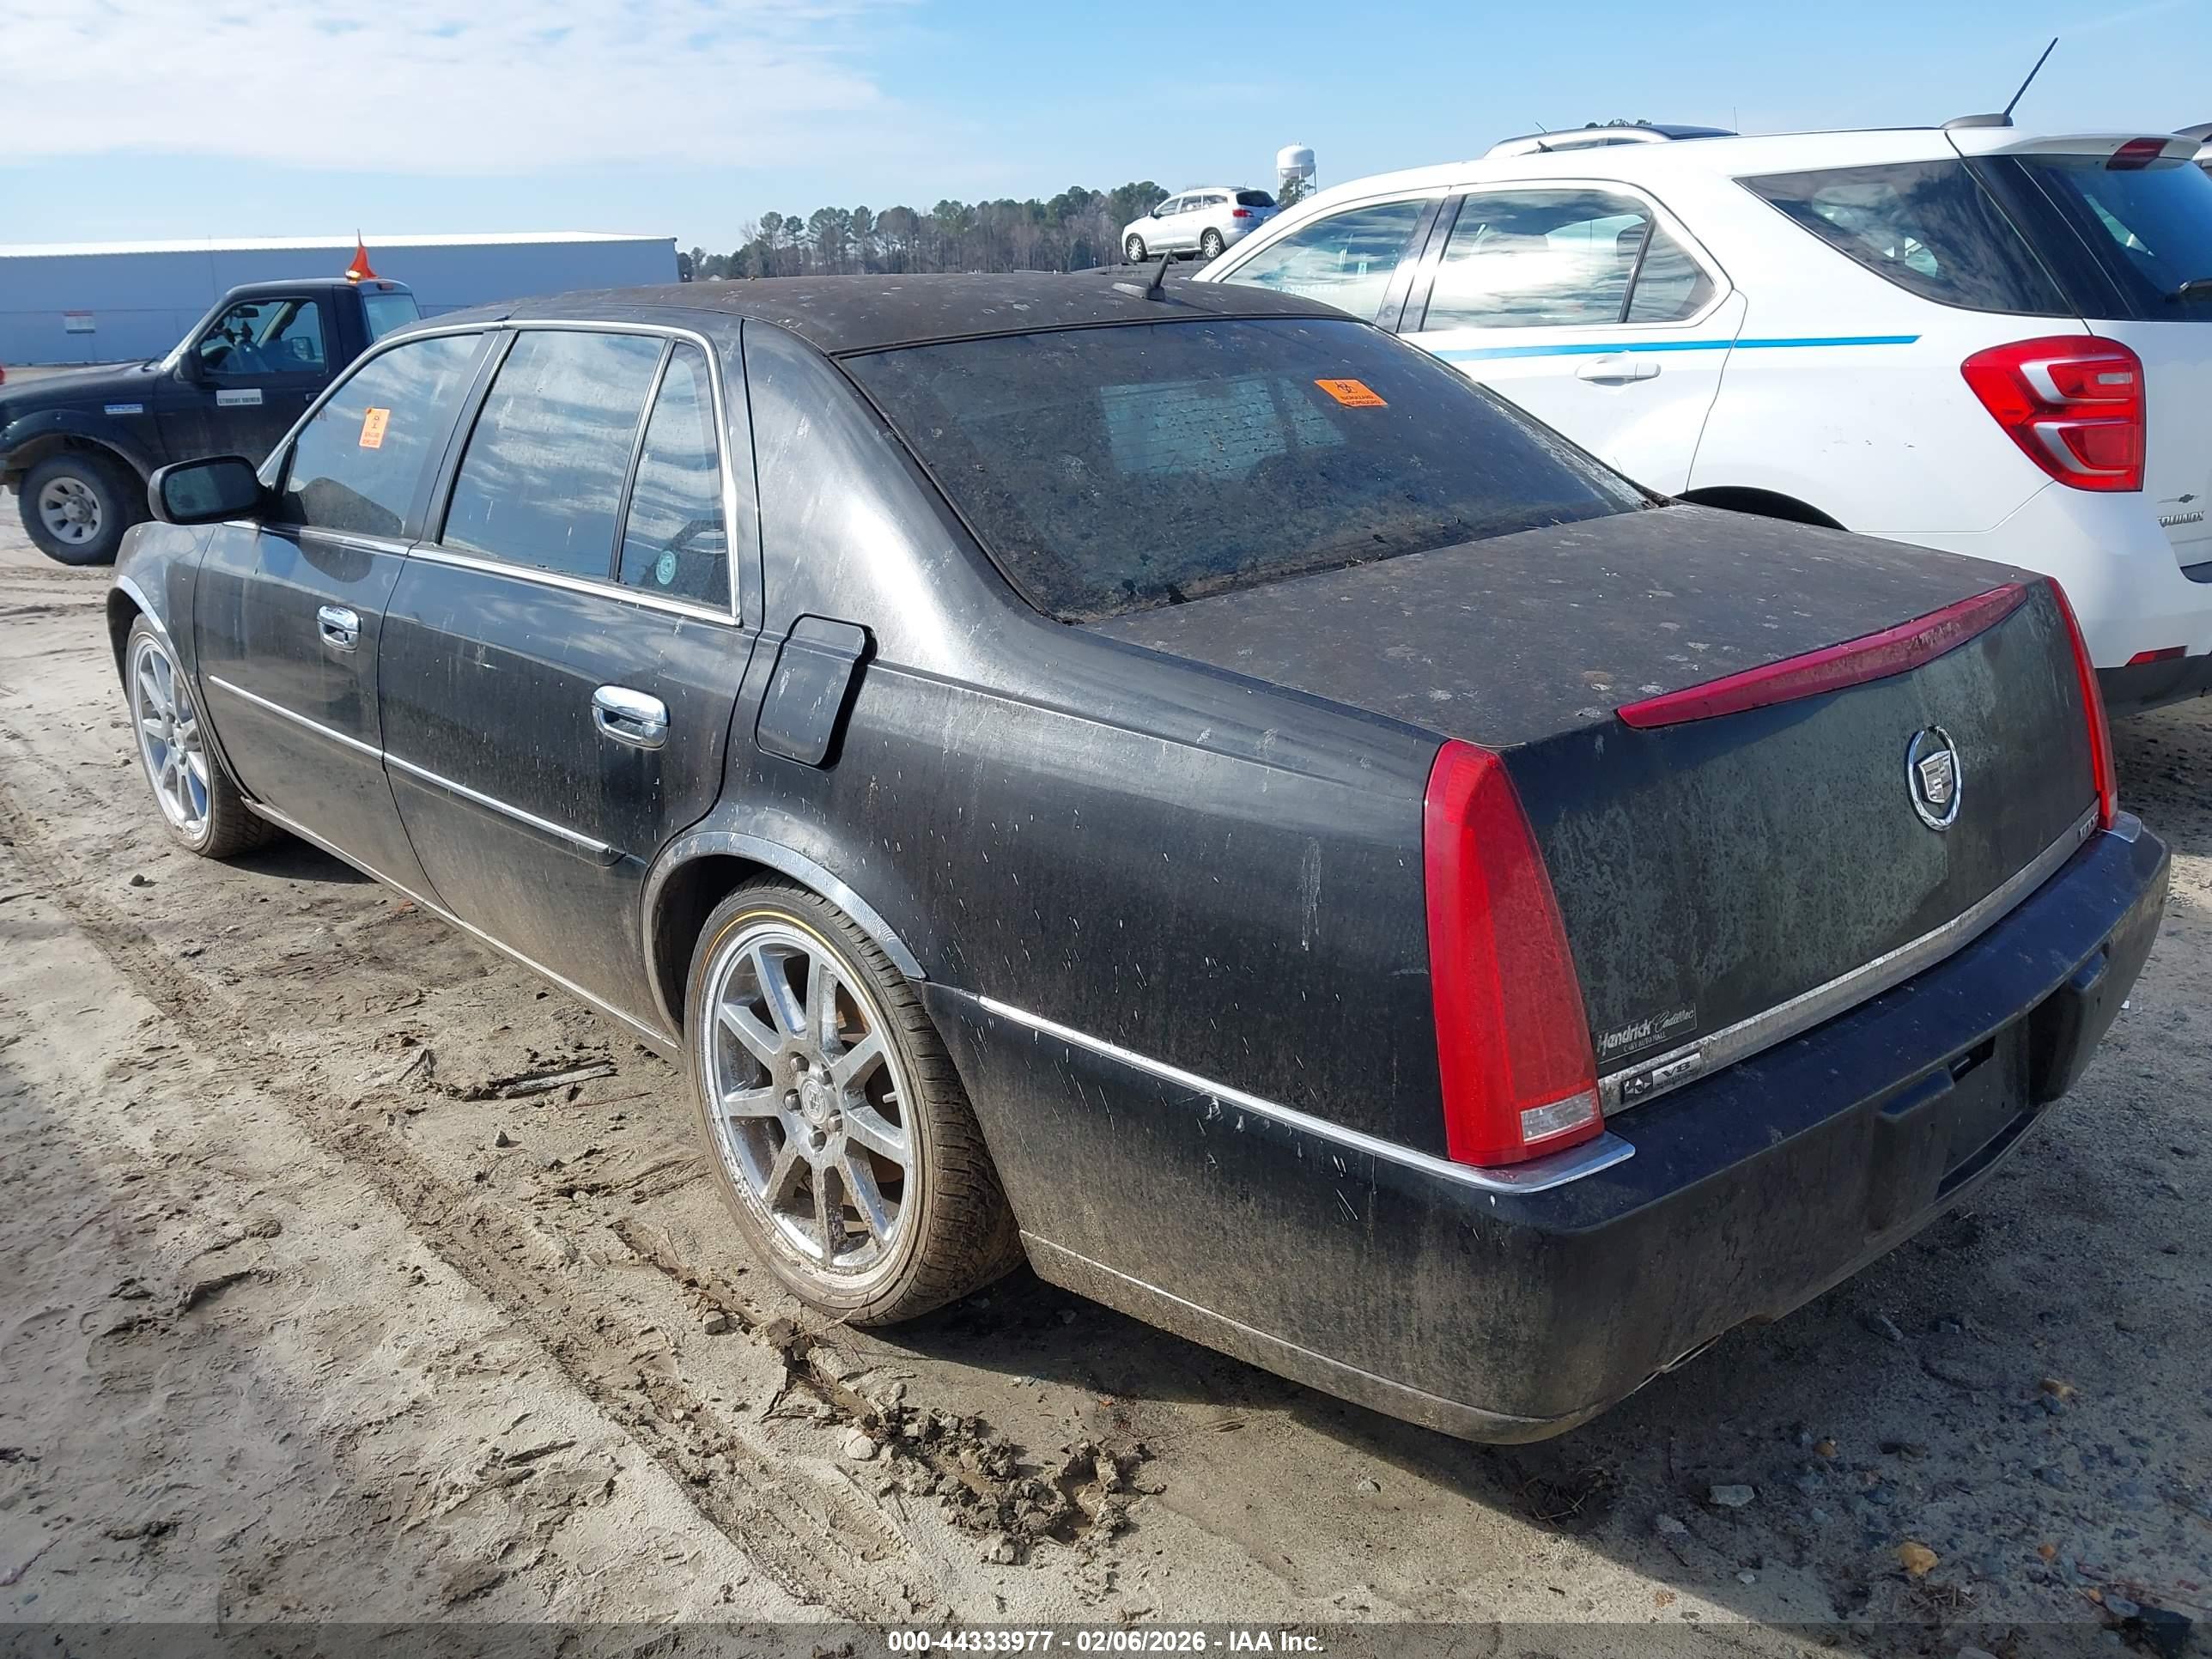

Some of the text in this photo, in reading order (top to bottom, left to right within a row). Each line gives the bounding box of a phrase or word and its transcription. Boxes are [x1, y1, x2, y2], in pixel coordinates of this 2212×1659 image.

[1597, 1009, 1694, 1056] Hendrick Cadillac
[1662, 1061, 1691, 1078] V8
